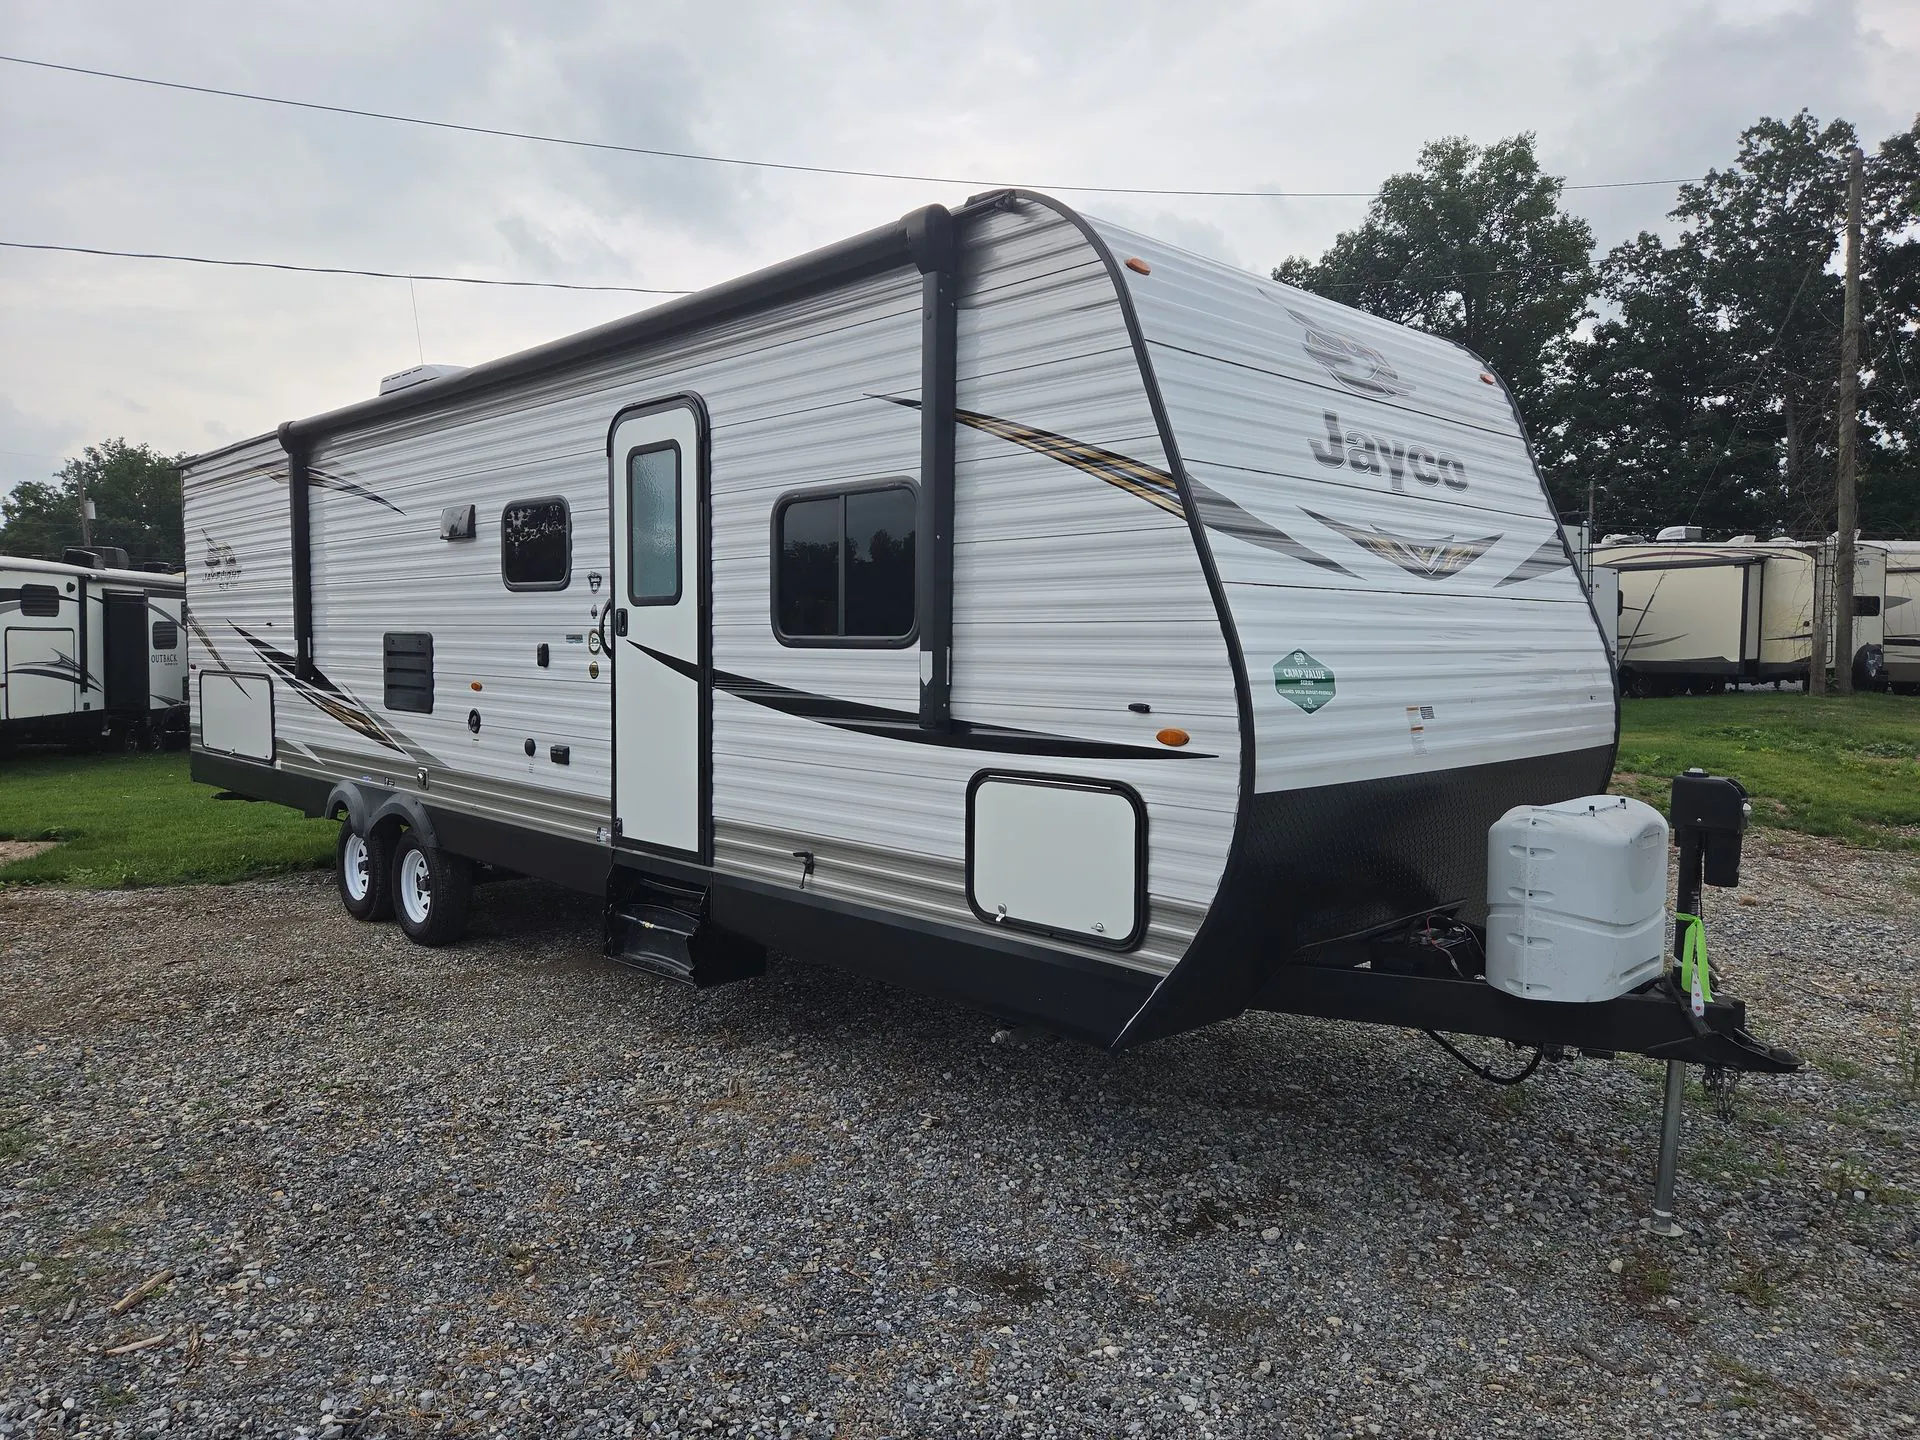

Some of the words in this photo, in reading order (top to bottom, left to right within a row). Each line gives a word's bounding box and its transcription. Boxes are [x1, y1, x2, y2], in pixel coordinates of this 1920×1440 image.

[1307, 408, 1469, 493] Jayco
[150, 654, 178, 663] OUTBACK
[1283, 668, 1304, 678] CAMP
[1303, 669, 1326, 679] VALUE
